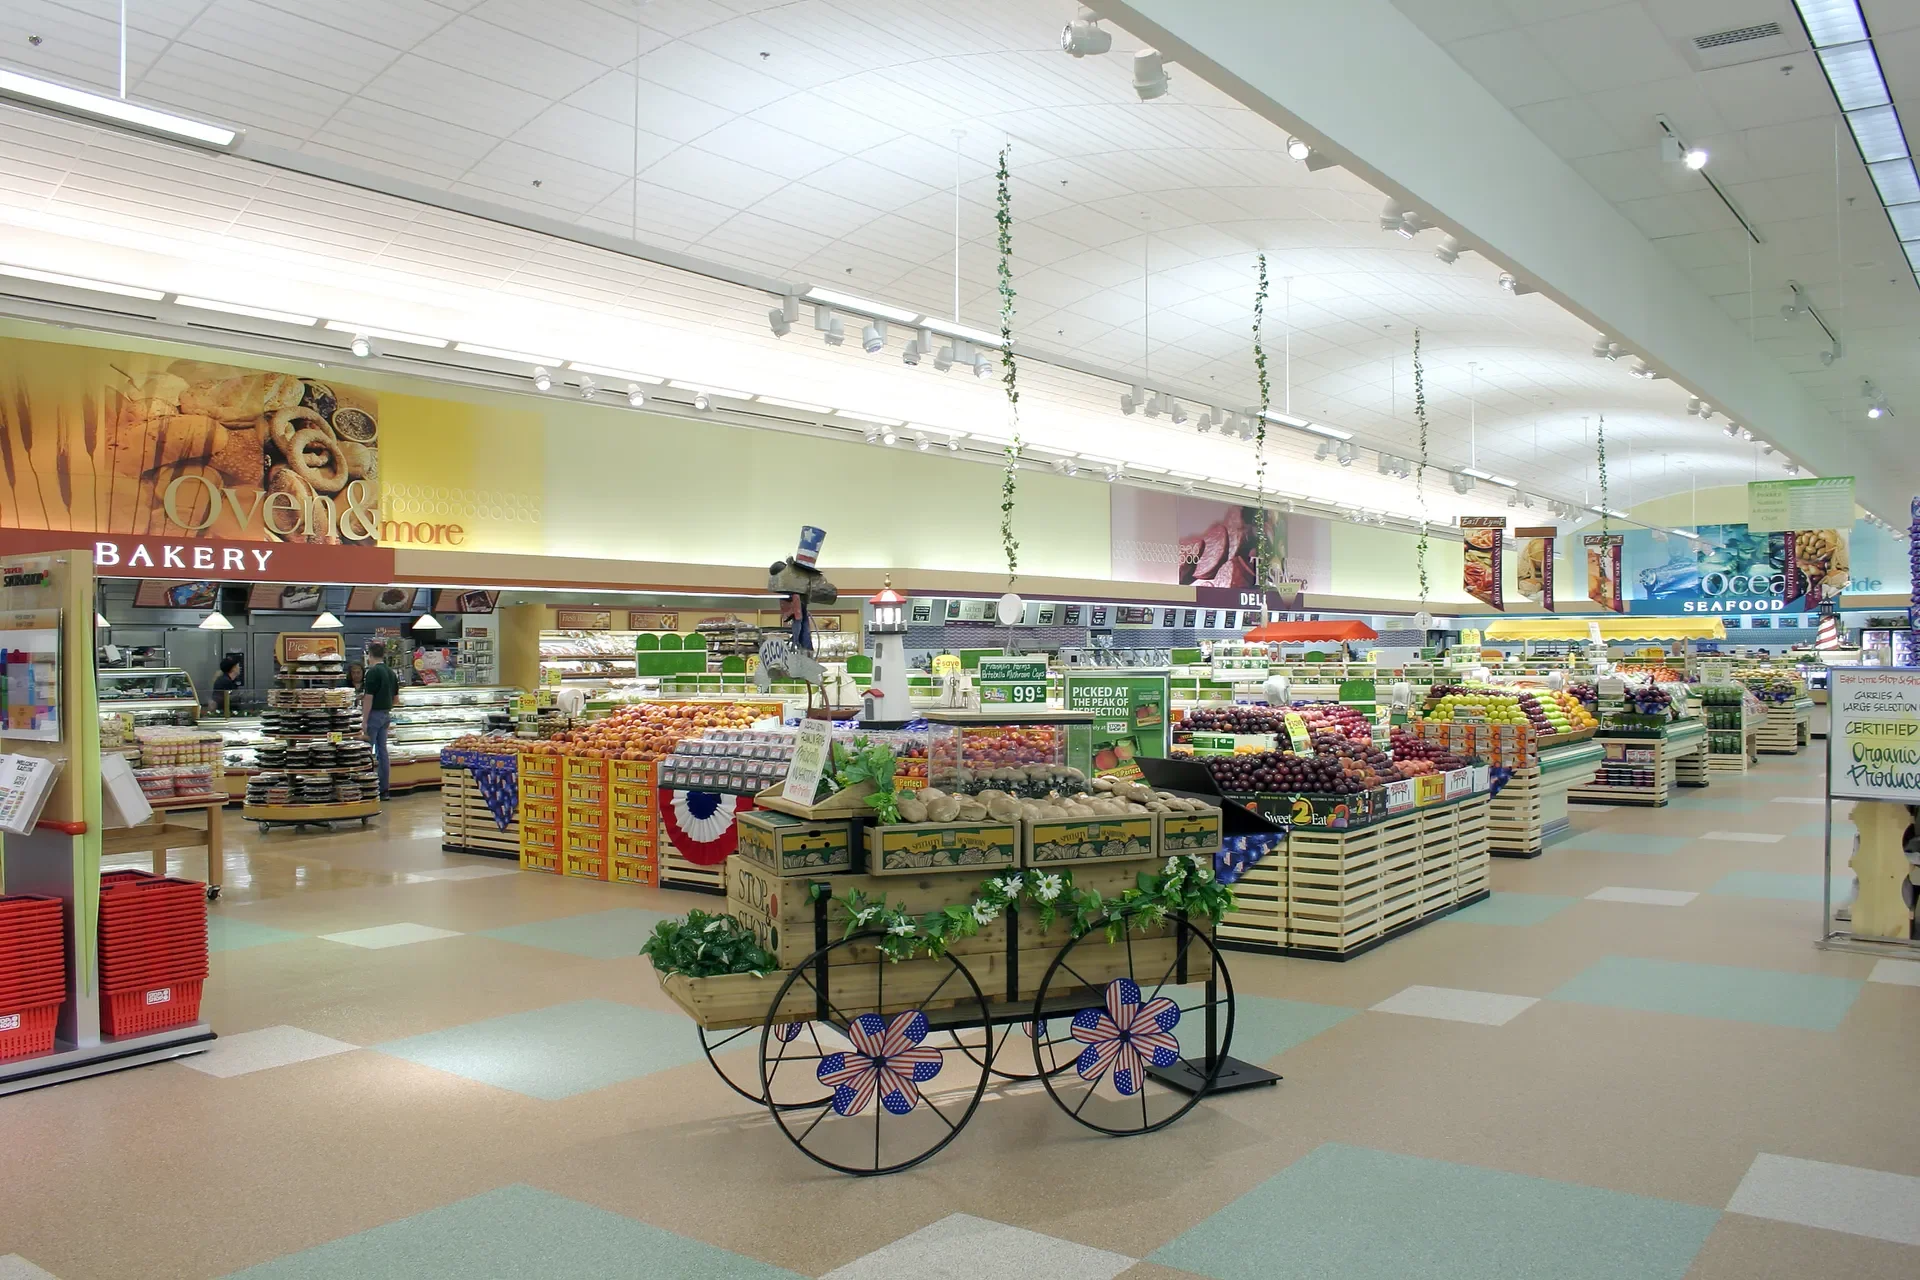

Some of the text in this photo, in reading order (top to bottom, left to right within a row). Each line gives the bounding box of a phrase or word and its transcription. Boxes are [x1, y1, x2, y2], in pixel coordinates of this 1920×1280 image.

[380, 519, 464, 545] more
[95, 542, 274, 571] BAKERY
[1683, 600, 1785, 612] SEAFOOD
[1032, 668, 1045, 680] Caps
[1840, 674, 1857, 684] East
[1858, 675, 1876, 685] Lyme
[1878, 674, 1898, 685] Stop
[1072, 687, 1112, 697] PICKED
[1115, 687, 1128, 697] AT
[1854, 691, 1903, 700] CARRIES A
[1073, 698, 1129, 706] THE PEAK OF
[1843, 702, 1917, 712] LARGE SELECTION
[1845, 721, 1918, 736] CERTIFIED
[1213, 738, 1218, 748] 1
[1852, 742, 1920, 769] Organic
[1120, 767, 1141, 777] Perfect
[1847, 764, 1920, 790] Produce
[899, 779, 922, 787] Perfect
[1264, 801, 1328, 825] Sweet 2 Eat
[1060, 831, 1086, 842] SPECIALTY
[911, 838, 940, 850] SPECIALTY
[739, 868, 768, 912] STOP
[765, 903, 772, 928] &
